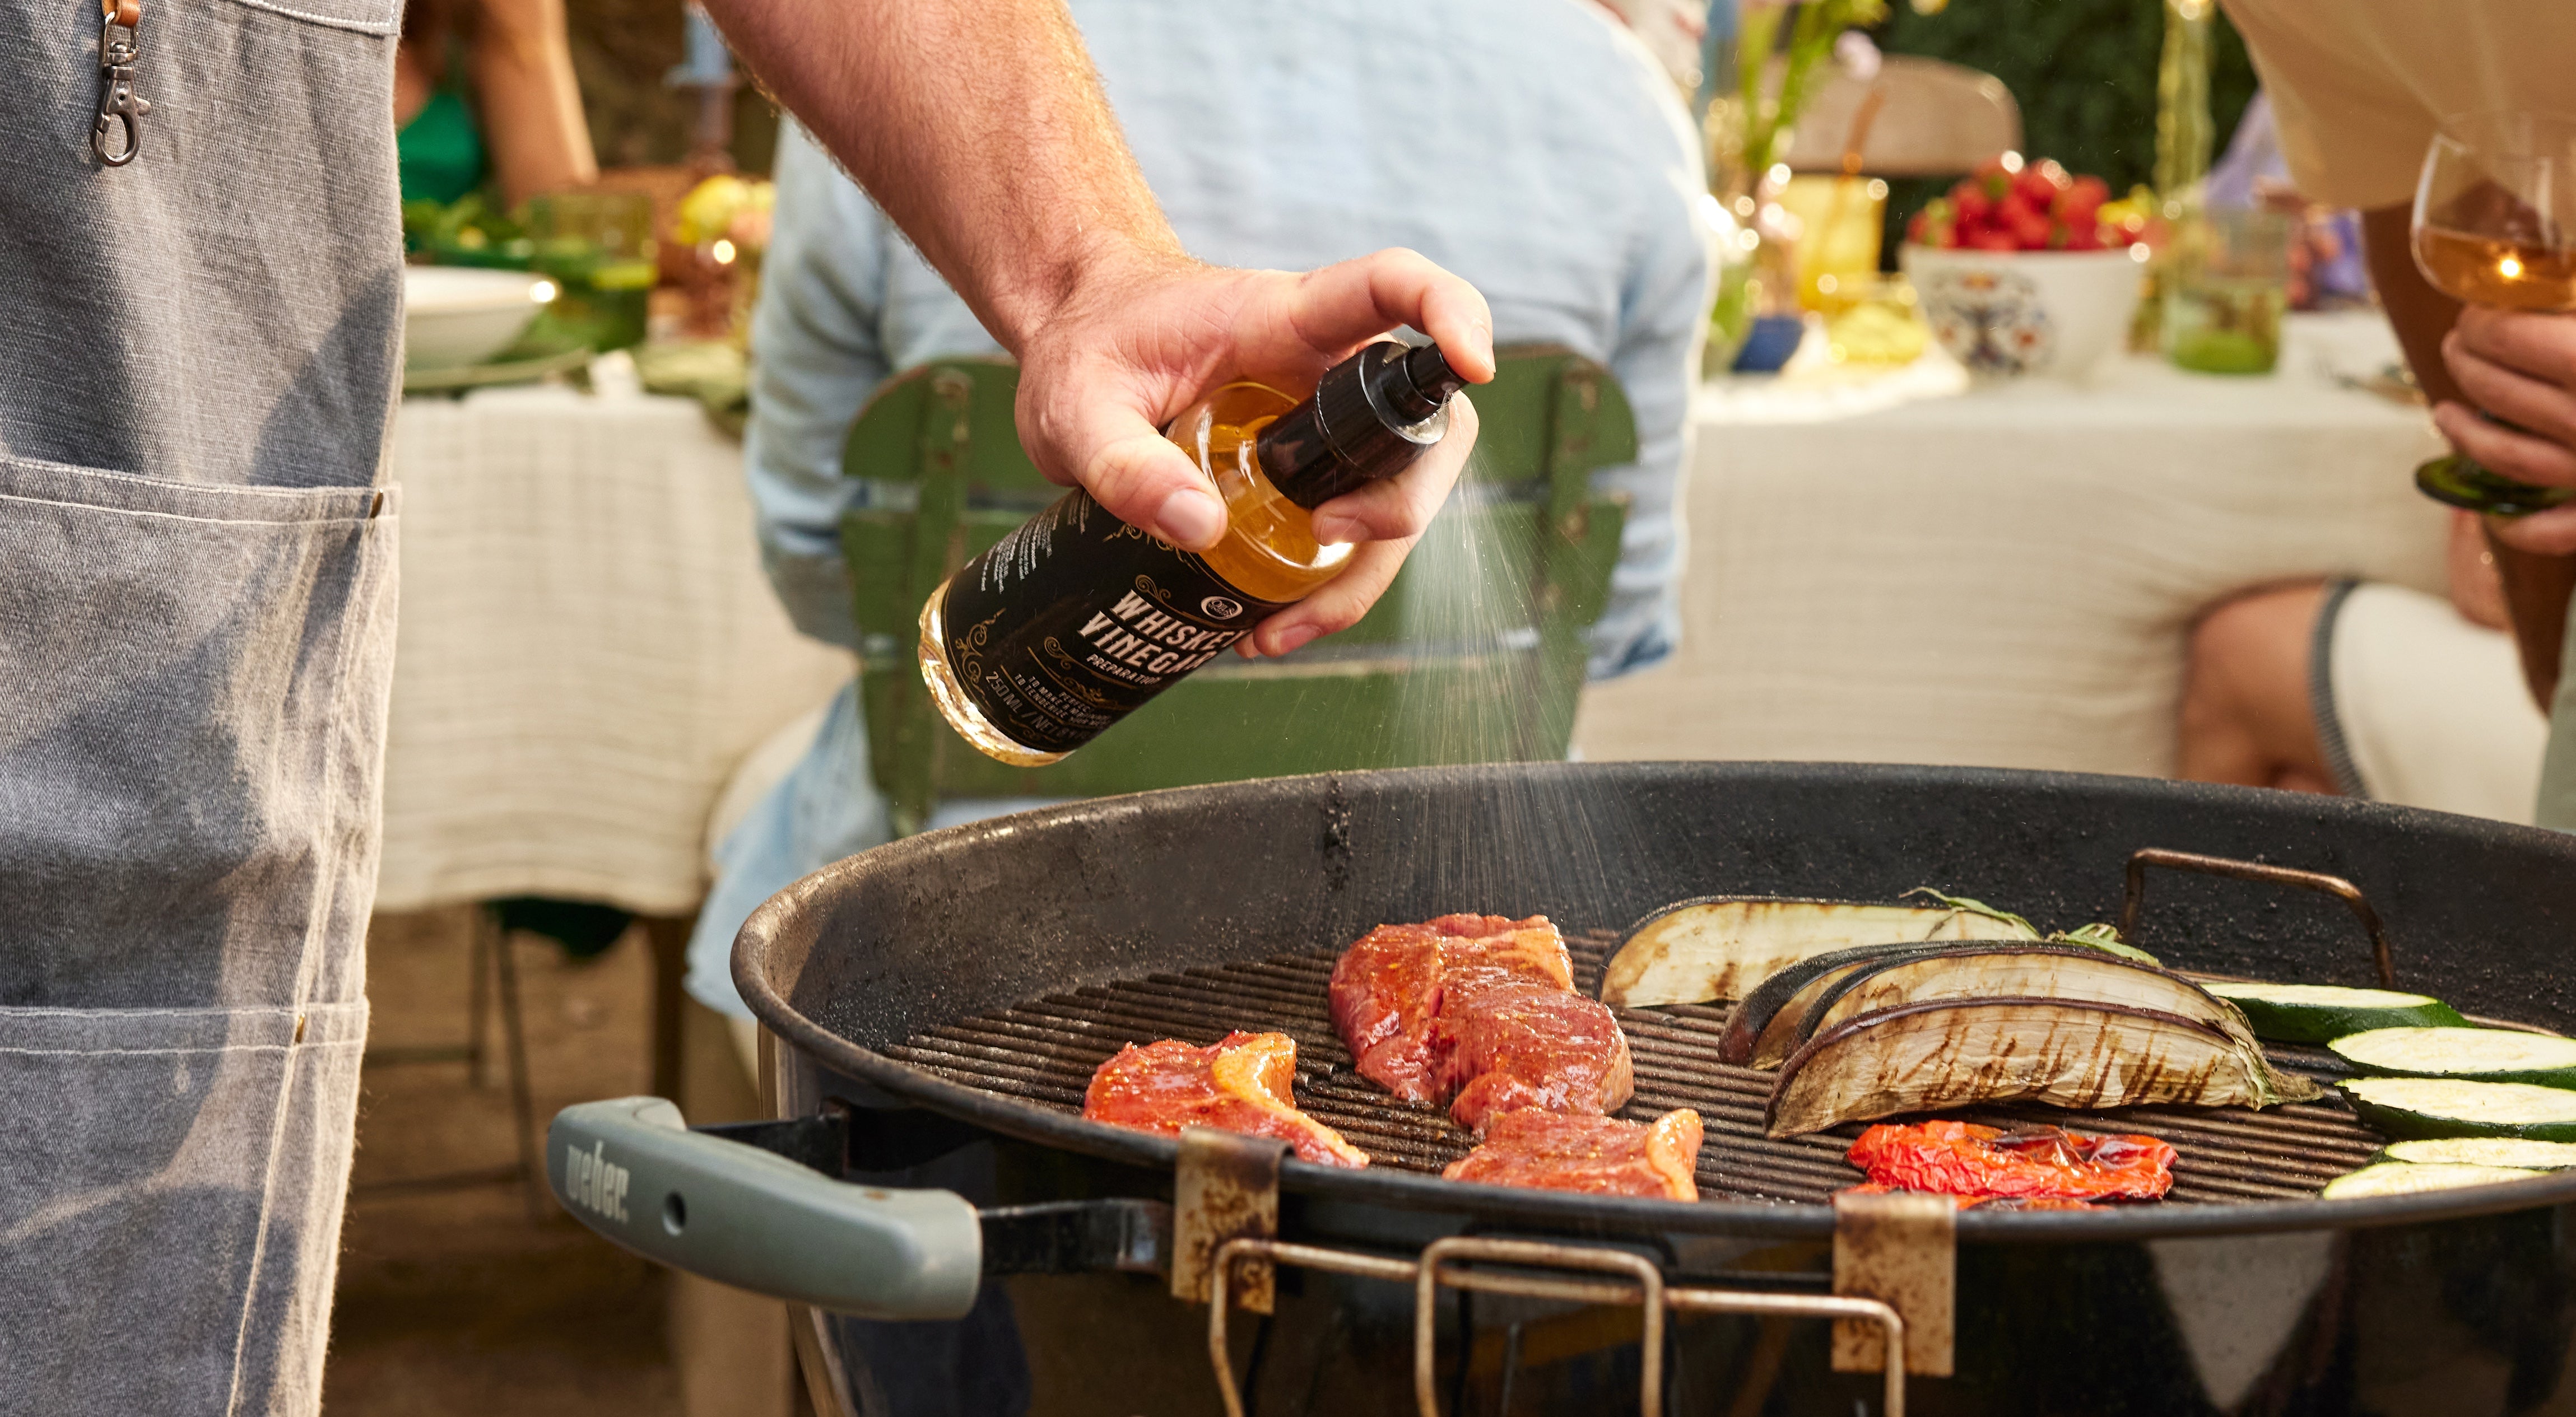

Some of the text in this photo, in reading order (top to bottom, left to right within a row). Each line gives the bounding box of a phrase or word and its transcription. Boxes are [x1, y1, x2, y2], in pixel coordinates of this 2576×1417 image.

[1077, 610, 1217, 674] VINEGAR
[985, 670, 1023, 714] 250ML
[1014, 673, 1026, 686] TO
[1024, 684, 1068, 718] TENDERIZE
